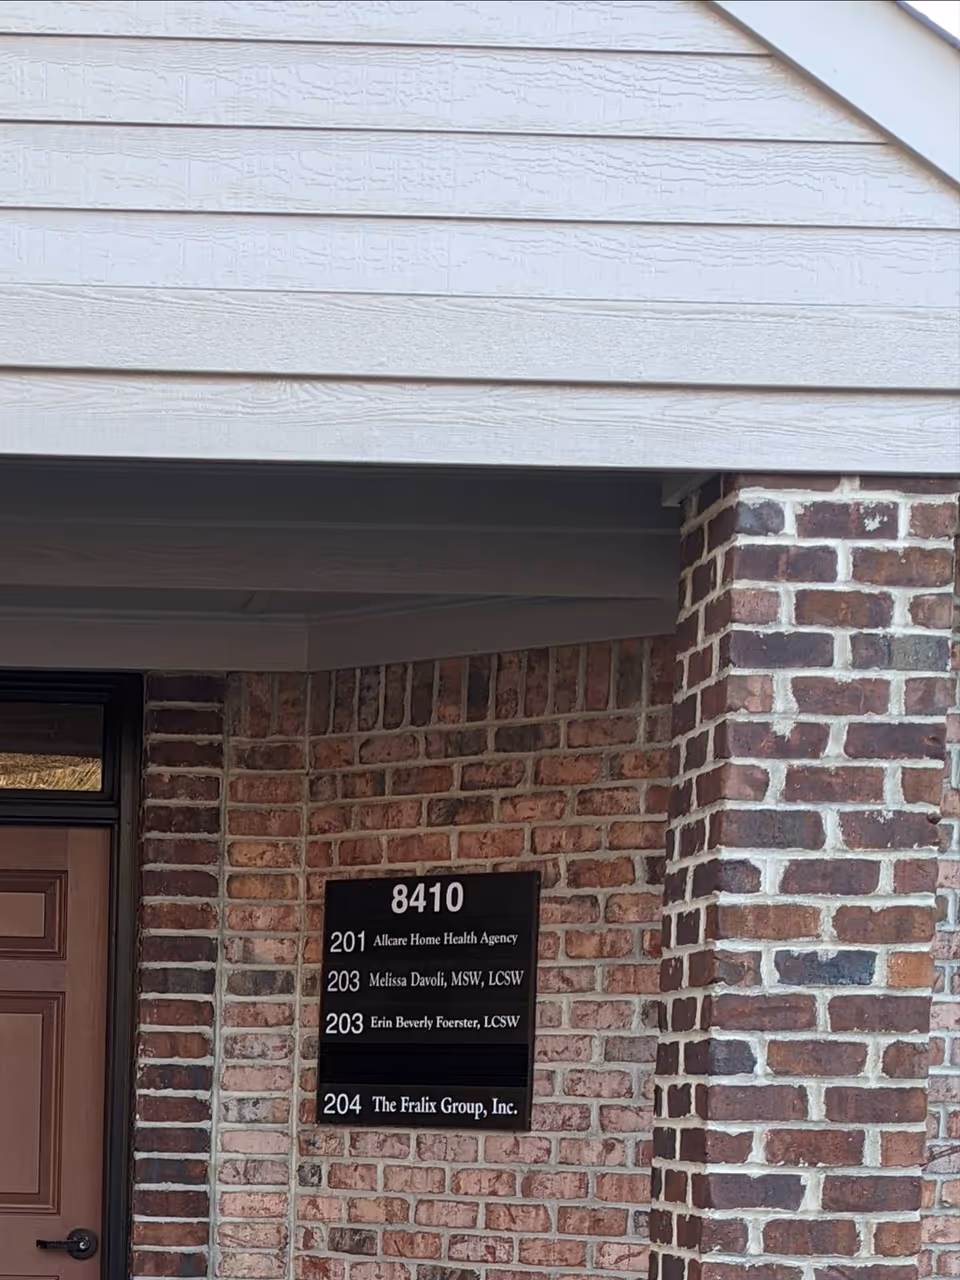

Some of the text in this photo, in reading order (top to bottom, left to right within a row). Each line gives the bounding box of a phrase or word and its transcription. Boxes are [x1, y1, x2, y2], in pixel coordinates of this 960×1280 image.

[392, 882, 463, 913] 8410
[330, 931, 518, 952] 201 Allcare Home Health Agency
[328, 971, 524, 991] 203 Melissa Davoli, MSW, LCSW
[326, 1013, 520, 1034] 203 Erin Beverly Foerster, LCSW
[324, 1093, 517, 1119] 204 The Fralix Group, Inc.
